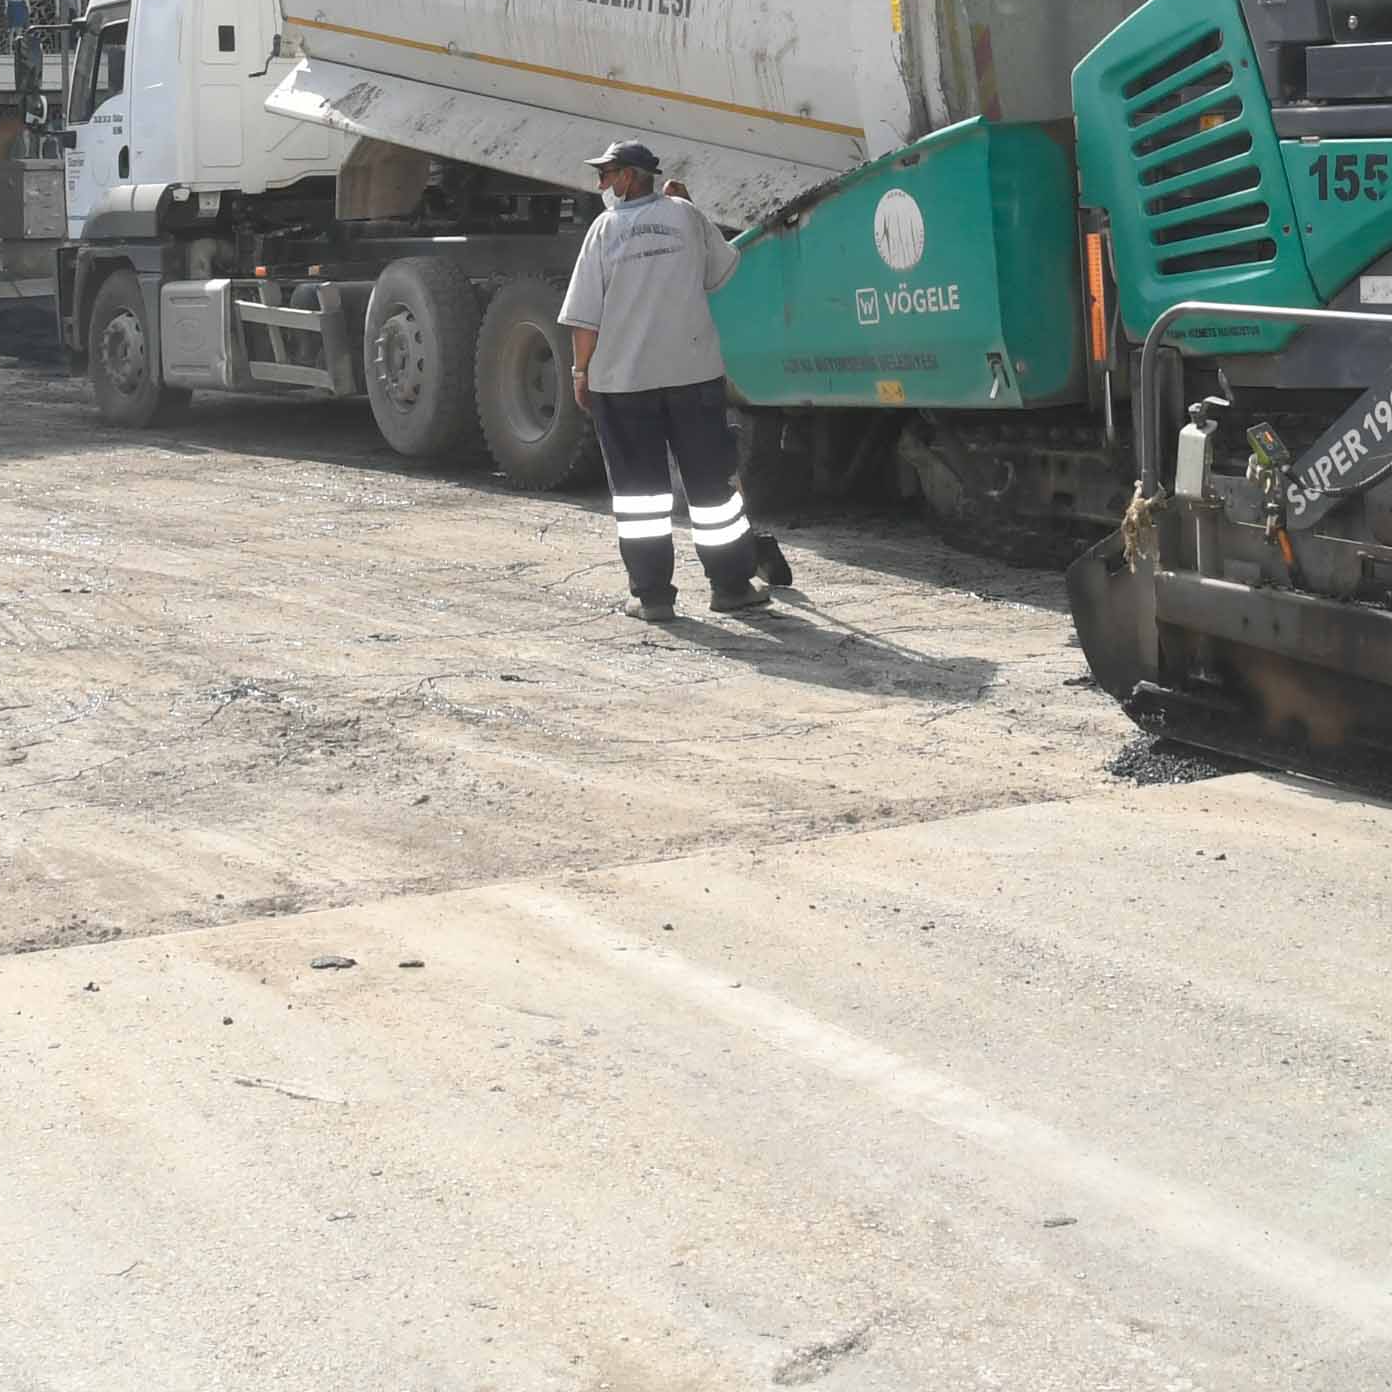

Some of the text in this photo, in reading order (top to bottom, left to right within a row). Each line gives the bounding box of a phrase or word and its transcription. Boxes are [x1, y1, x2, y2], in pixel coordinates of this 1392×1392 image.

[1309, 154, 1388, 201] 155
[884, 283, 961, 315] VÖGELE
[1287, 428, 1369, 516] SUPER
